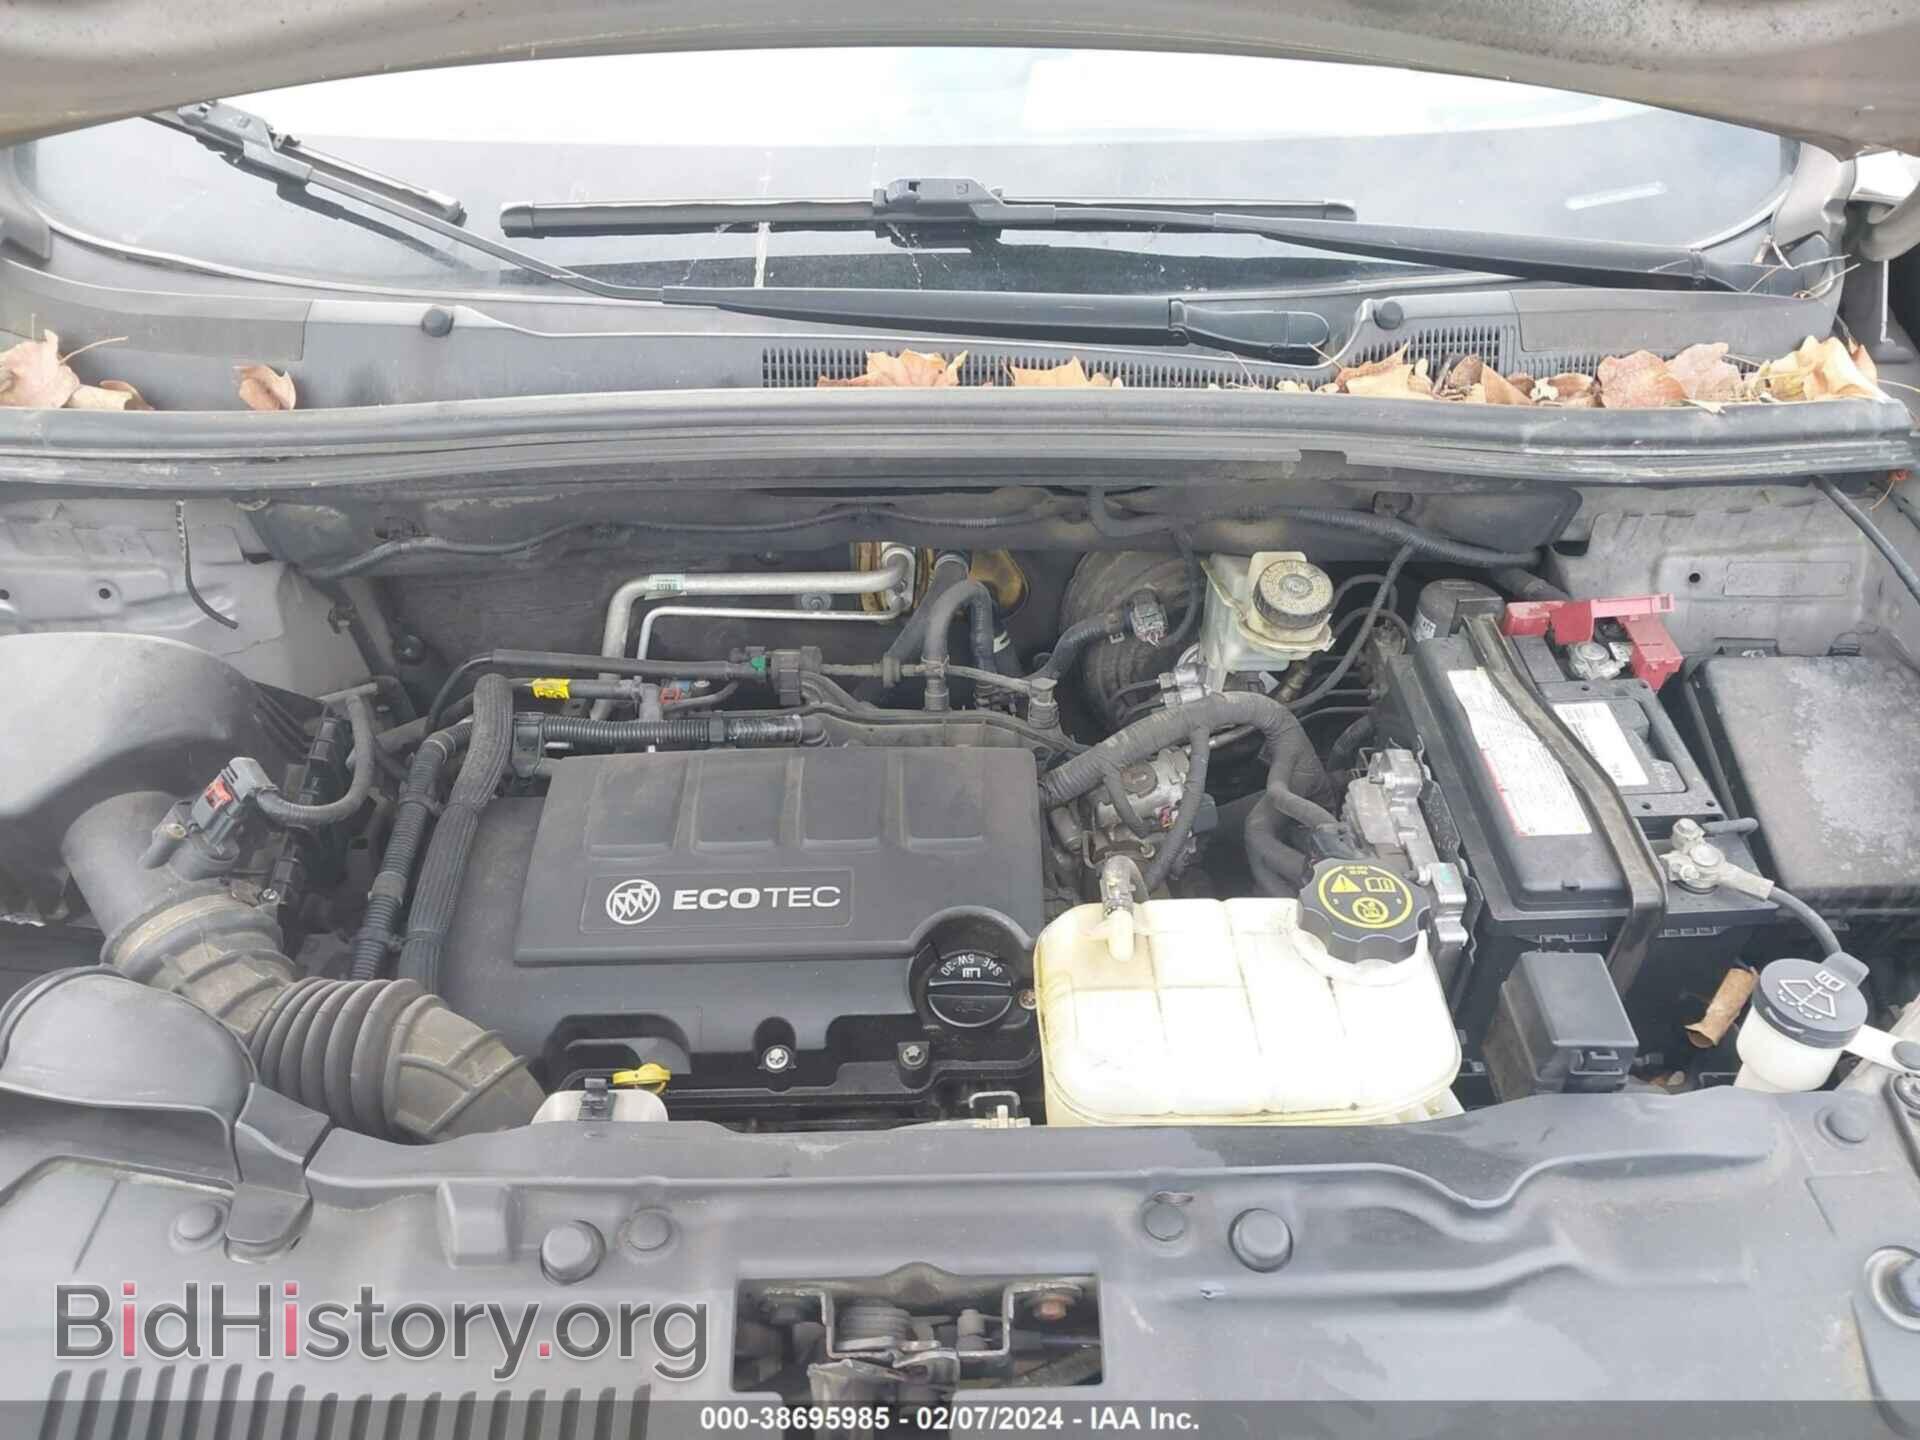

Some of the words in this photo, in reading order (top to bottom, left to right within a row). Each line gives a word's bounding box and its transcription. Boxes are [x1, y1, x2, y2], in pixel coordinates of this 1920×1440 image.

[672, 886, 841, 910] ECOTEC
[940, 953, 976, 977] 5W-30
[982, 957, 1003, 977] SAE
